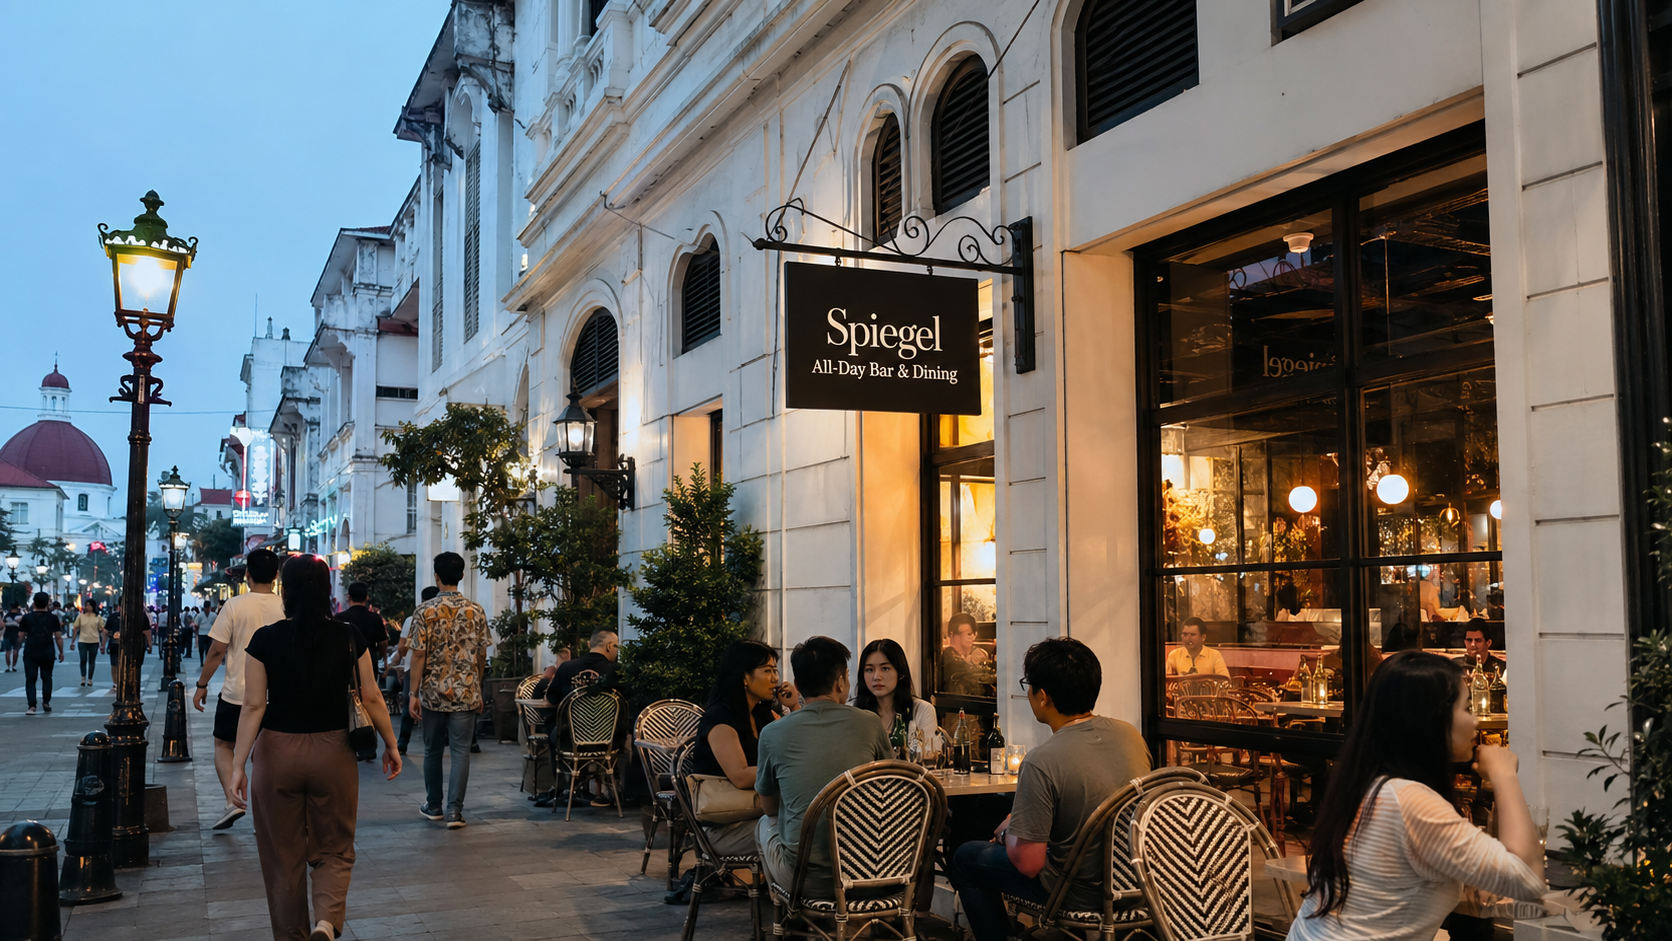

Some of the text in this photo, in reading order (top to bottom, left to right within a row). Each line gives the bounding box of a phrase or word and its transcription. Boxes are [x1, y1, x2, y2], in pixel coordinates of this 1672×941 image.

[827, 307, 943, 360] Spiegel
[811, 359, 958, 385] All-Day Bar & Dining
